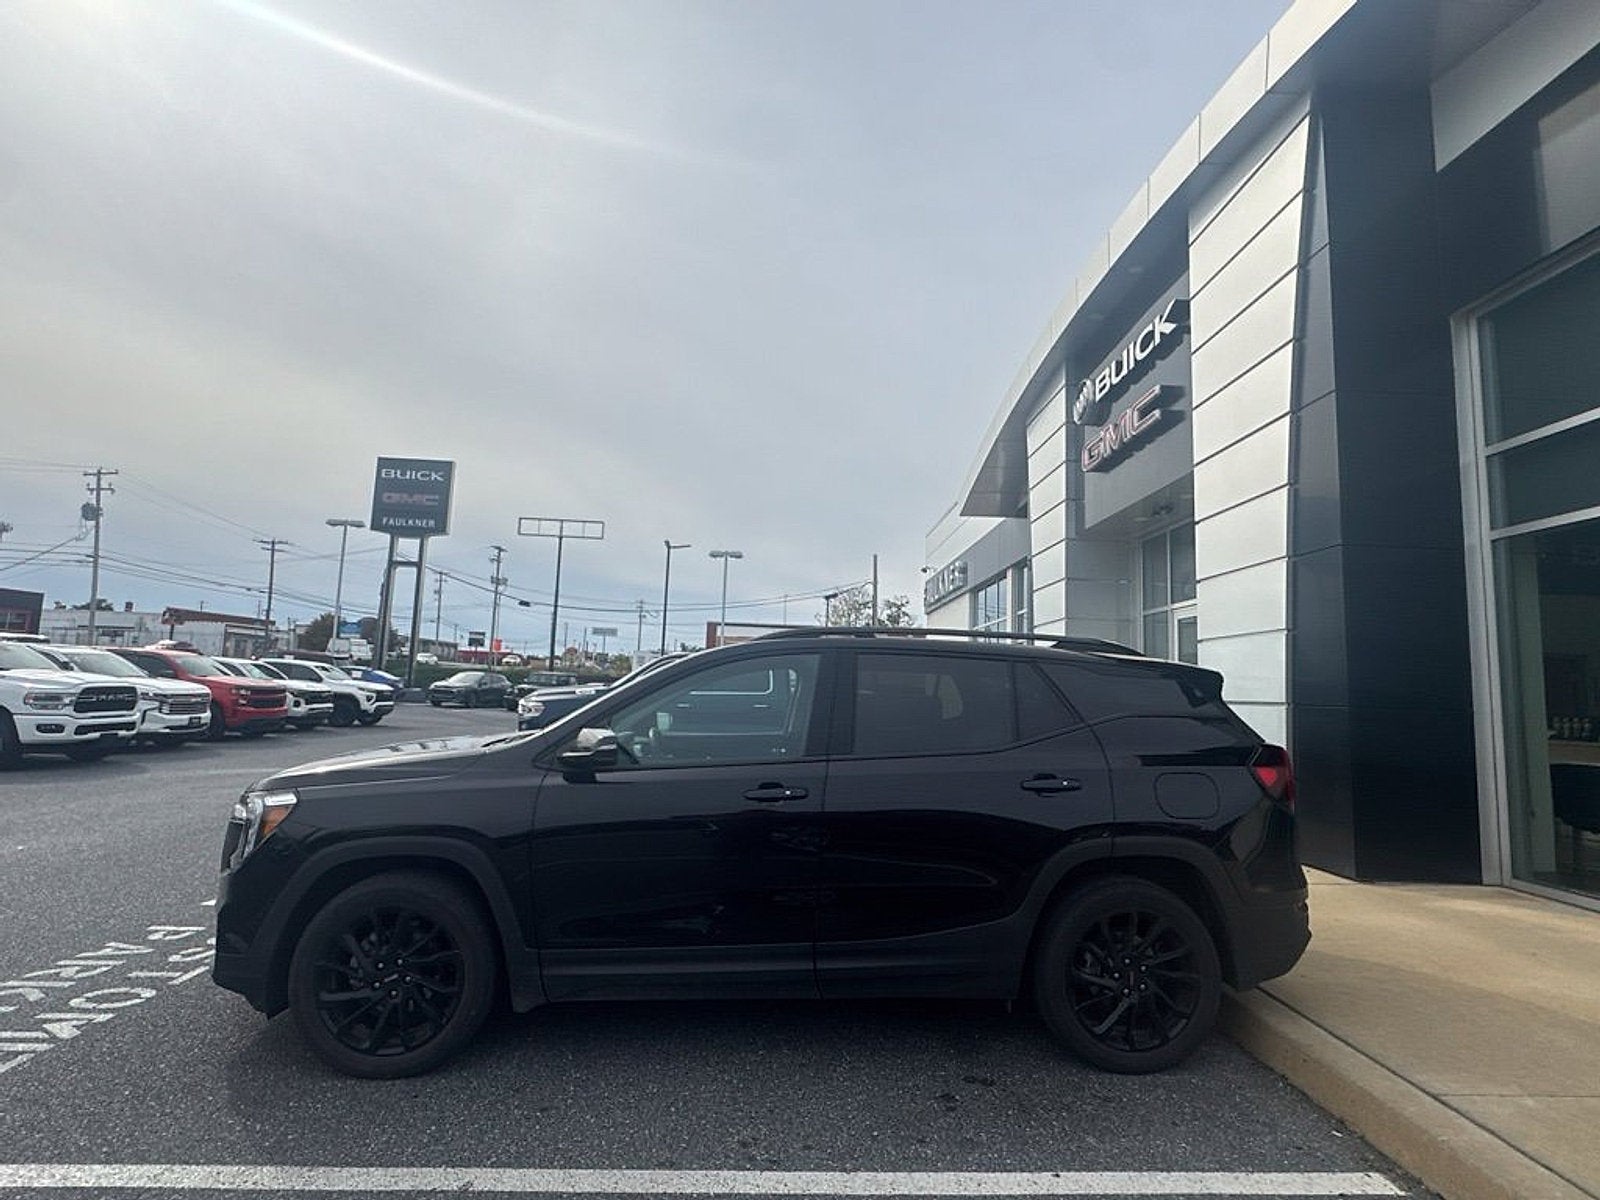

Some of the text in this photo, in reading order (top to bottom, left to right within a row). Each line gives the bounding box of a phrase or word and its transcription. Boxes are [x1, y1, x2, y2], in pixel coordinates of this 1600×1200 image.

[1095, 298, 1179, 403] BUICK
[1081, 384, 1162, 472] GMC
[381, 468, 445, 482] BUICK
[382, 492, 439, 506] GMC
[382, 516, 436, 528] FAULKNER
